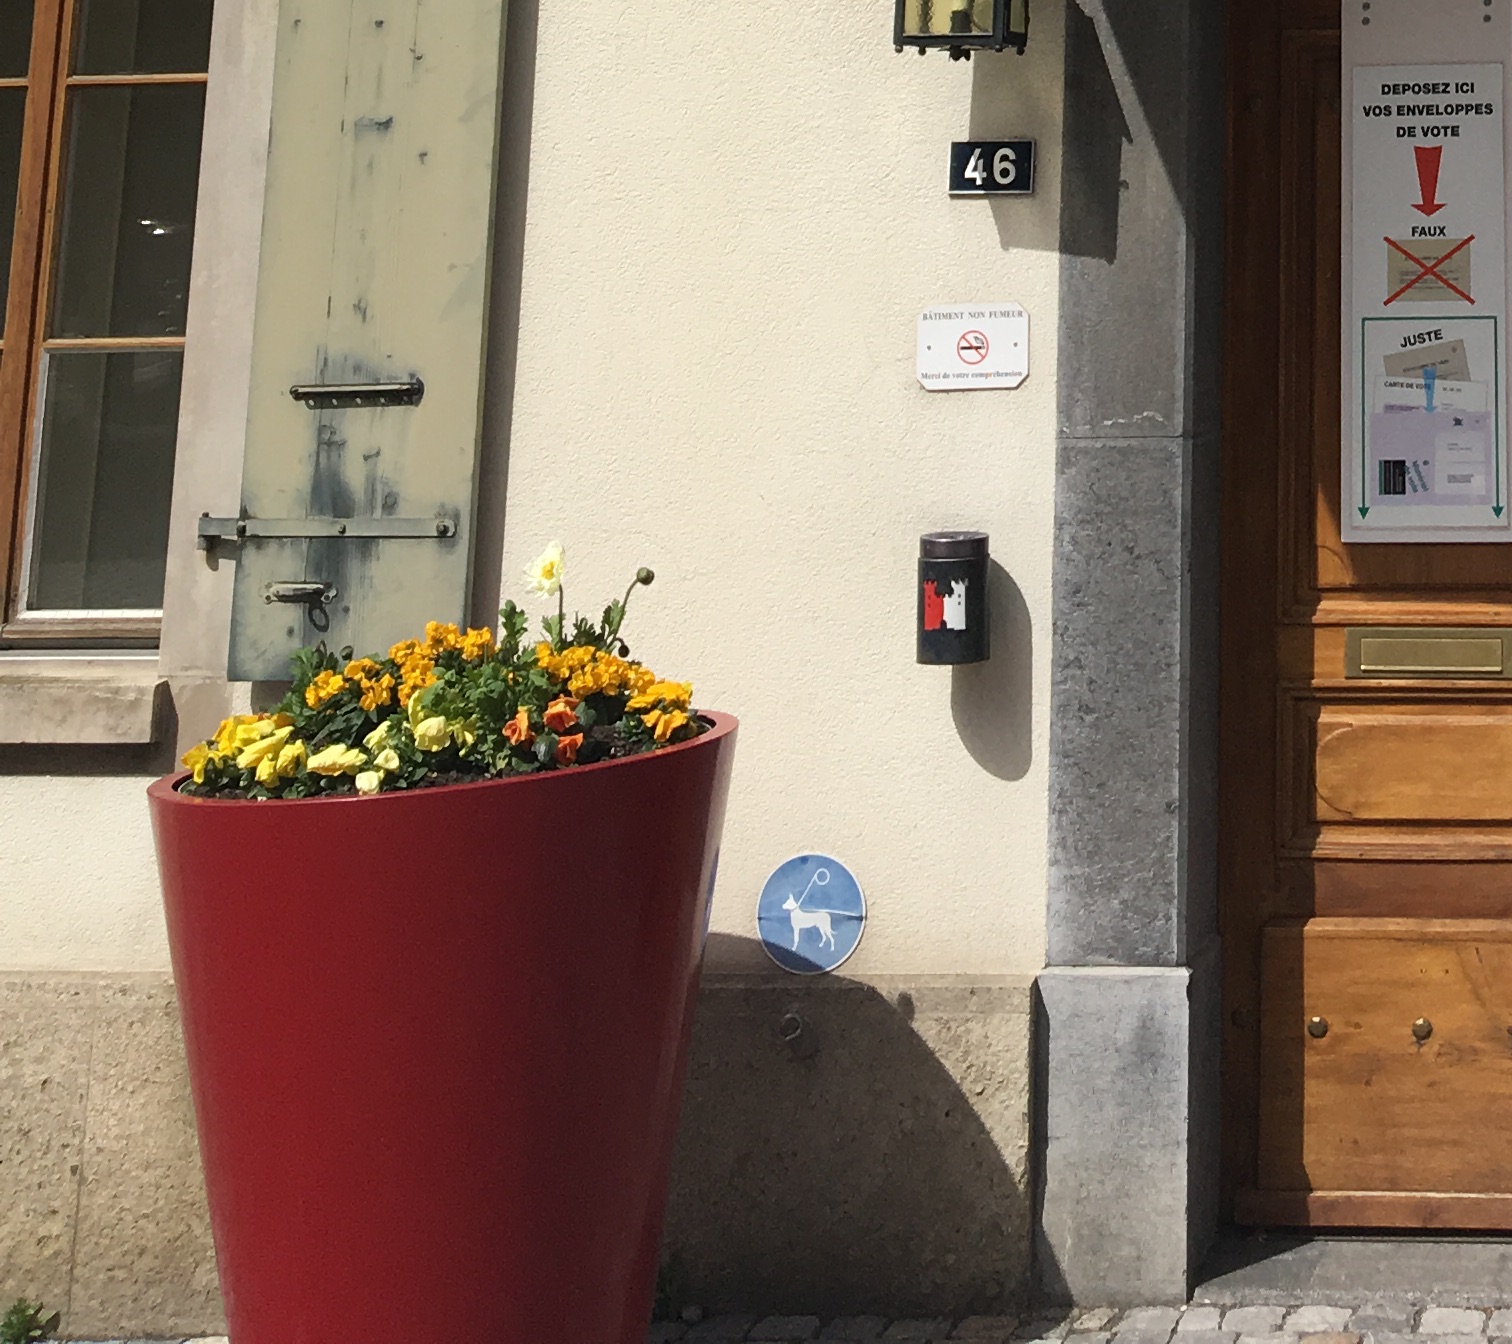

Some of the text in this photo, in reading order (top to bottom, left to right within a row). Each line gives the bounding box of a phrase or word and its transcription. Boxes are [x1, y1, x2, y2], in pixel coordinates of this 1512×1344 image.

[1381, 82, 1475, 96] DEPOSEZ ICI
[1362, 102, 1494, 117] VOS ENVELOPPES
[1396, 125, 1460, 138] DE VOTE
[963, 147, 1017, 186] 46
[1411, 226, 1447, 238] FAUX
[922, 310, 1024, 321] BÂTIMENT NON FUMEUR
[1400, 328, 1444, 348] JUSTE
[921, 372, 941, 380] Merci
[951, 372, 970, 380] votre
